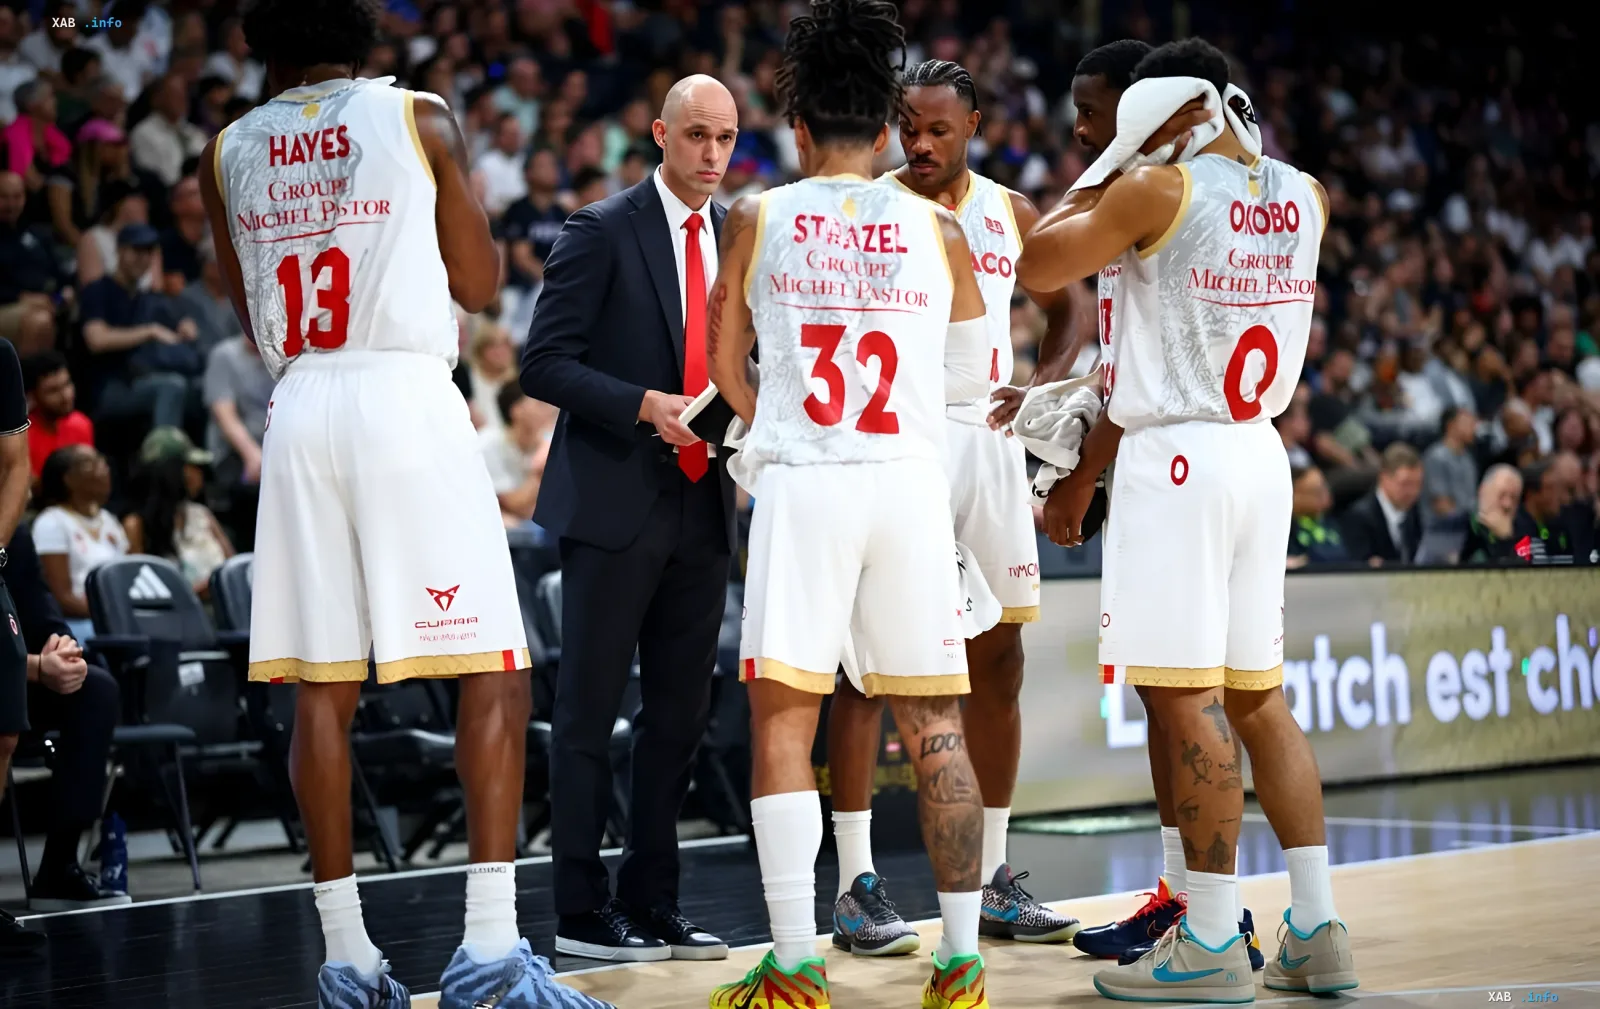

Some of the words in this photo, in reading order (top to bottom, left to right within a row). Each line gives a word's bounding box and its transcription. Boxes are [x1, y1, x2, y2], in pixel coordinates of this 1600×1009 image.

[269, 125, 350, 167] HAYES
[237, 208, 316, 231] MICHEL
[793, 214, 908, 254] STRAZEL
[1229, 200, 1300, 235] OKOBO
[806, 249, 892, 278] GROUPE
[1228, 247, 1295, 270] GROUPE
[769, 272, 850, 297] MICHEL
[857, 280, 929, 308] PASTOR
[1187, 267, 1263, 293] MICHEL
[276, 246, 351, 358] 13
[800, 323, 900, 435] 32
[1223, 324, 1279, 422] 0
[1170, 454, 1189, 486] 0
[414, 616, 478, 629] CUPRA
[1426, 625, 1513, 724] est
